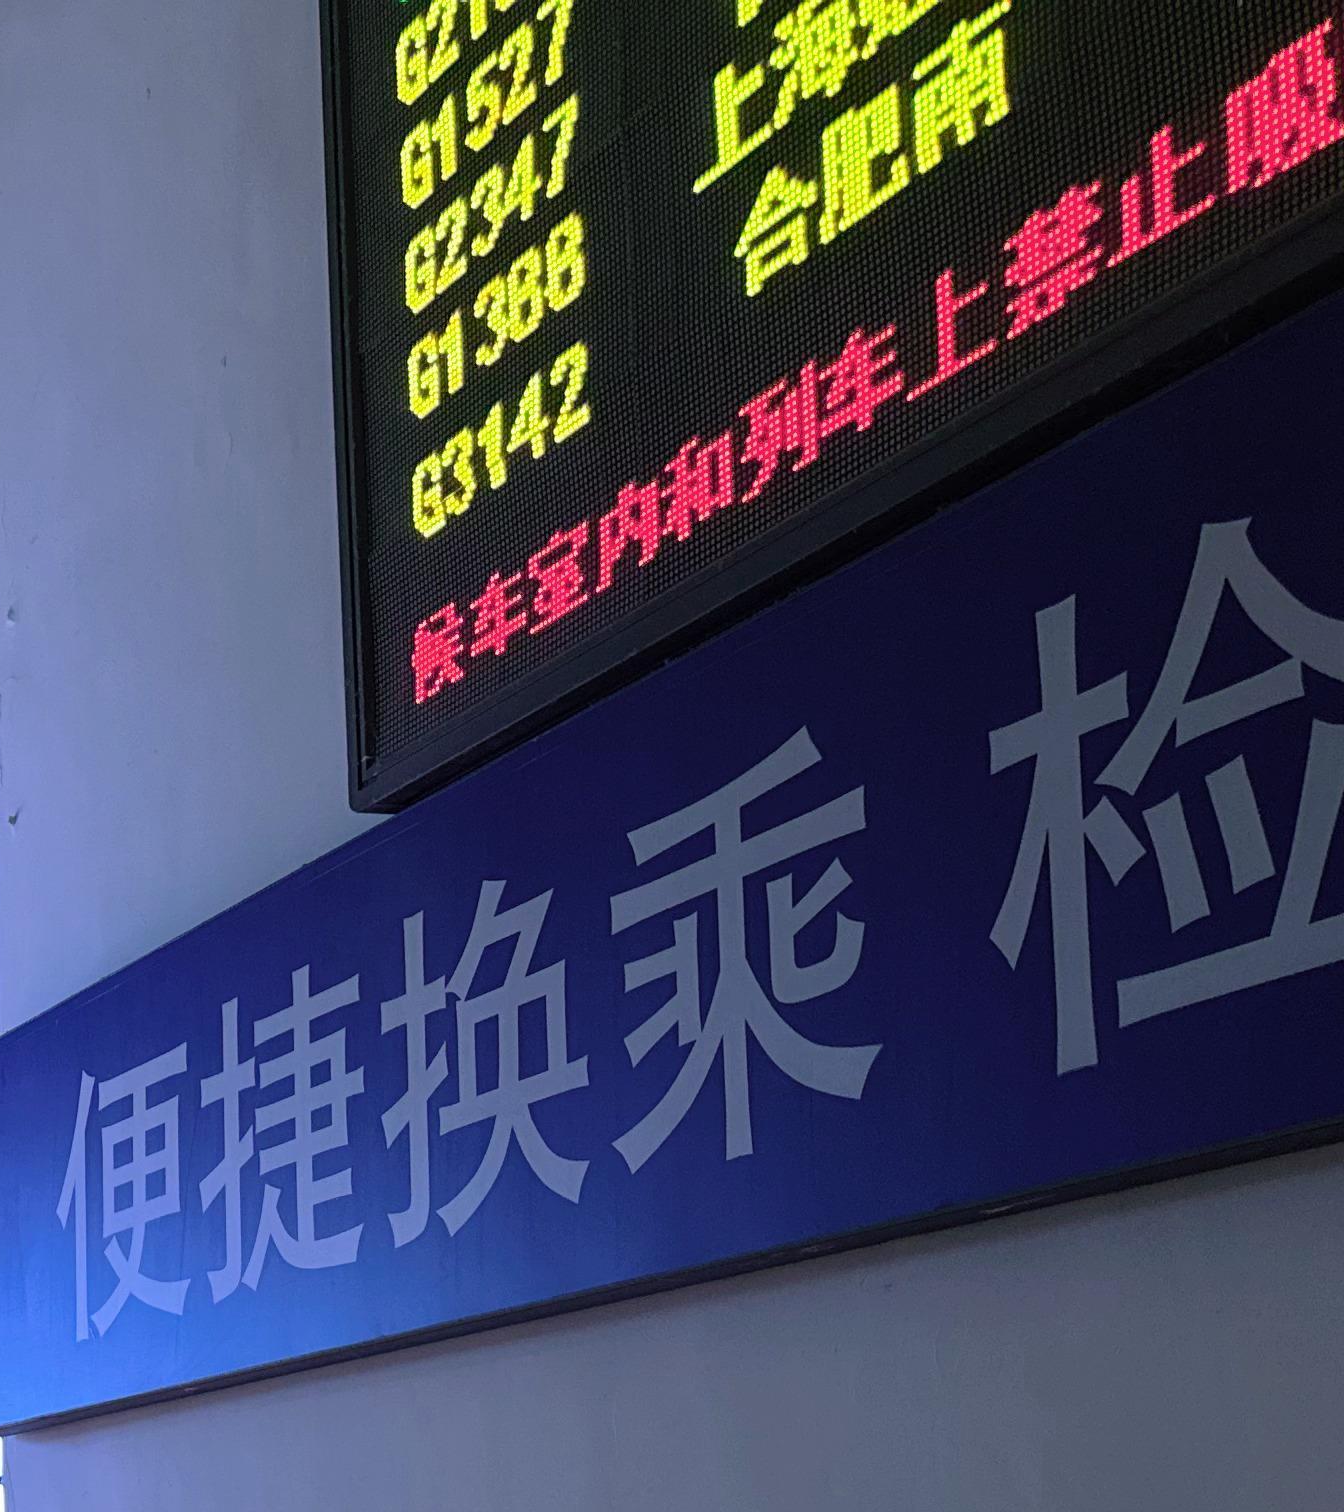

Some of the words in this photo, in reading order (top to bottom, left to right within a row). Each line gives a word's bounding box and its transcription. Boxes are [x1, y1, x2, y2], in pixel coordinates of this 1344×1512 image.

[400, 0, 575, 209] G1527
[404, 92, 580, 315] G2347
[733, 0, 1012, 297] 合肥南
[407, 209, 588, 420] G1388
[411, 339, 592, 538] G3142
[56, 725, 882, 1342] 便捷换乘
[988, 516, 1344, 1076] 检
